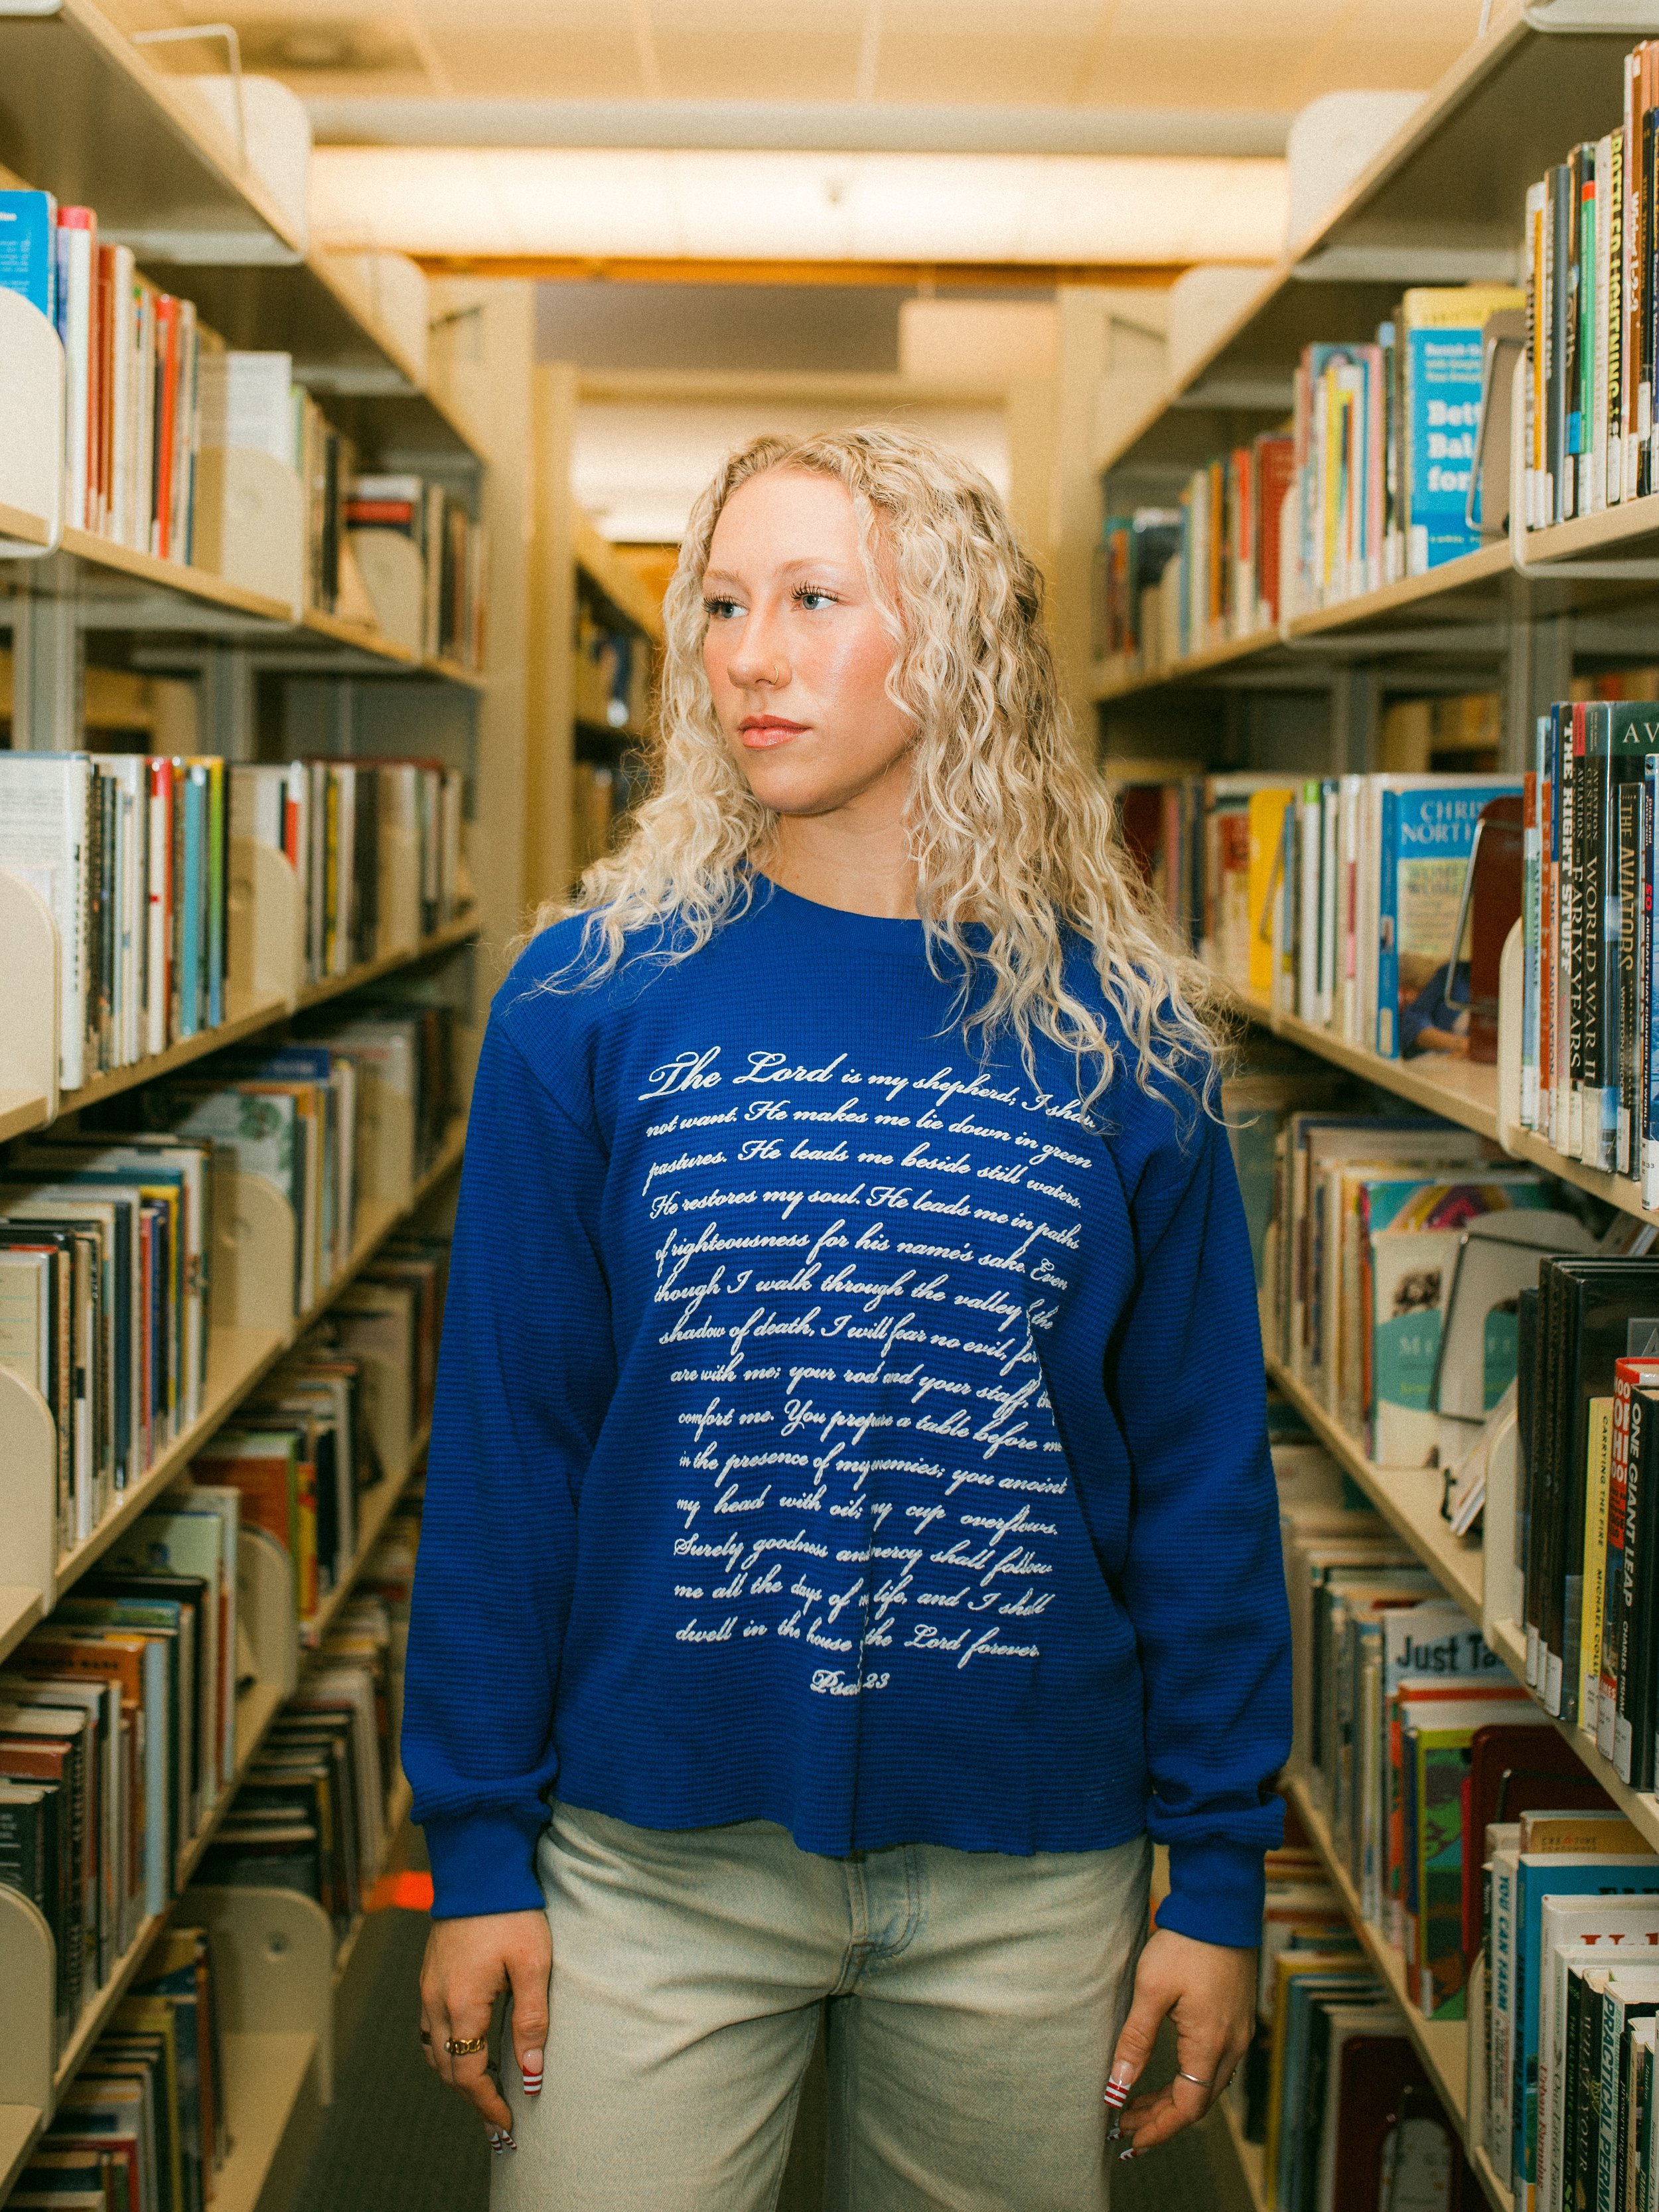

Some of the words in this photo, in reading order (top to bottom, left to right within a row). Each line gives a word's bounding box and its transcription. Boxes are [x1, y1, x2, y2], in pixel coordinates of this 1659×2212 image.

[1609, 258, 1622, 400] LIGHTNING
[1427, 432, 1475, 459] Bal
[1563, 721, 1573, 779] THE
[1421, 800, 1484, 824] CHRI
[1562, 787, 1573, 877] RIGHT
[1621, 804, 1633, 838] THE
[1571, 864, 1583, 962] EARLY
[1585, 855, 1598, 972] WORLD
[1618, 846, 1634, 970] AVIATORS
[1644, 883, 1653, 911] 50
[1561, 883, 1573, 974] STUFF
[1570, 970, 1582, 1067] YEARS
[1585, 981, 1597, 1048] WAR
[638, 1046, 722, 1100] The
[733, 1051, 848, 1084] Lord
[841, 1069, 862, 1083] is
[868, 1075, 908, 1101] my
[913, 1067, 1020, 1106] shepherd;
[1022, 1095, 1050, 1111] I
[1585, 1059, 1596, 1080] II
[646, 1115, 679, 1137] not
[680, 1113, 737, 1129] want.
[744, 1100, 790, 1121] He
[793, 1098, 869, 1123] makes
[875, 1115, 910, 1126] me
[916, 1109, 944, 1130] lie
[948, 1114, 1011, 1141] down
[1015, 1132, 1039, 1148] in
[1040, 1145, 1092, 1168] green
[642, 1152, 727, 1197] pastures.
[738, 1139, 784, 1160] He
[790, 1139, 849, 1161] leads
[857, 1153, 893, 1165] me
[901, 1142, 971, 1173] beside
[977, 1165, 1020, 1184] still
[1027, 1180, 1081, 1209] waters.
[650, 1191, 680, 1219] He
[682, 1189, 757, 1211] restores
[762, 1191, 804, 1220] my
[808, 1183, 865, 1205] soul.
[866, 1187, 912, 1209] He
[912, 1190, 971, 1216] leads
[974, 1209, 1009, 1223] me
[1011, 1213, 1034, 1230] in
[1023, 1223, 1082, 1249] paths
[656, 1228, 677, 1278] of
[672, 1222, 810, 1274] righteousness
[806, 1219, 849, 1265] for
[855, 1222, 890, 1251] his
[897, 1242, 974, 1262] name's
[1031, 1258, 1067, 1290] Even
[654, 1271, 725, 1315] though
[727, 1270, 753, 1293] I
[756, 1262, 822, 1291] walk
[821, 1264, 904, 1312] through
[911, 1274, 948, 1301] the
[954, 1291, 1022, 1332] valley
[1031, 1305, 1059, 1329] the
[659, 1315, 725, 1344] shadow
[729, 1307, 764, 1356] of
[754, 1307, 815, 1337] death,
[821, 1315, 852, 1337] I
[847, 1317, 894, 1339] will
[881, 1313, 926, 1358] fear
[930, 1335, 961, 1348] no
[964, 1341, 1007, 1361] evil,
[671, 1369, 698, 1382] are
[701, 1352, 745, 1382] with
[743, 1367, 781, 1380] me;
[786, 1367, 836, 1394] your
[843, 1361, 885, 1383] rod
[883, 1364, 924, 1384] and
[911, 1376, 972, 1404] your
[678, 1397, 735, 1442] comfort
[739, 1411, 774, 1425] me.
[781, 1400, 826, 1436] You
[897, 1418, 911, 1427] a
[916, 1410, 971, 1438] table
[973, 1420, 1038, 1459] before
[1600, 1416, 1609, 1484] CARRYING
[1630, 1402, 1641, 1458] ONE
[680, 1451, 691, 1467] in
[693, 1441, 719, 1470] the
[715, 1453, 808, 1487] presence
[813, 1441, 845, 1485] of
[835, 1460, 870, 1491] my
[945, 1470, 995, 1495] you
[999, 1478, 1067, 1494] anoint
[677, 1499, 700, 1529] my
[714, 1484, 771, 1513] head
[780, 1485, 827, 1511] with
[830, 1494, 866, 1519] oil;
[871, 1503, 893, 1532] my
[906, 1505, 946, 1534] cup
[960, 1505, 1057, 1546] overflows.
[1625, 1462, 1638, 1544] GIANT
[674, 1532, 744, 1573] Surely
[741, 1530, 828, 1570] goodness
[930, 1540, 995, 1570] shall
[980, 1546, 1052, 1587] follow
[1623, 1546, 1635, 1607] LEAP
[674, 1585, 703, 1598] me
[712, 1573, 748, 1598] all
[751, 1564, 783, 1594] the
[791, 1574, 822, 1615] days
[828, 1578, 864, 1624] of
[874, 1577, 907, 1620] life,
[917, 1587, 970, 1607] and
[968, 1593, 1001, 1610] I
[999, 1588, 1055, 1616] shall
[676, 1616, 738, 1643] dwell
[743, 1621, 767, 1637] in
[778, 1611, 801, 1639] the
[806, 1617, 852, 1652] house
[865, 1617, 895, 1647] the
[904, 1625, 971, 1650] Lord
[1396, 1635, 1459, 1671] Just
[863, 1673, 890, 1688] 23
[1499, 1876, 1510, 1911] YOU
[1498, 1917, 1509, 1955] CAN
[1497, 1959, 1508, 2011] FARM
[1540, 2065, 1548, 2115] Urban
[1601, 1995, 1615, 2130] PRACTICAL
[1538, 2121, 1548, 2191] Farming
[1579, 2105, 1589, 2172] YOUR
